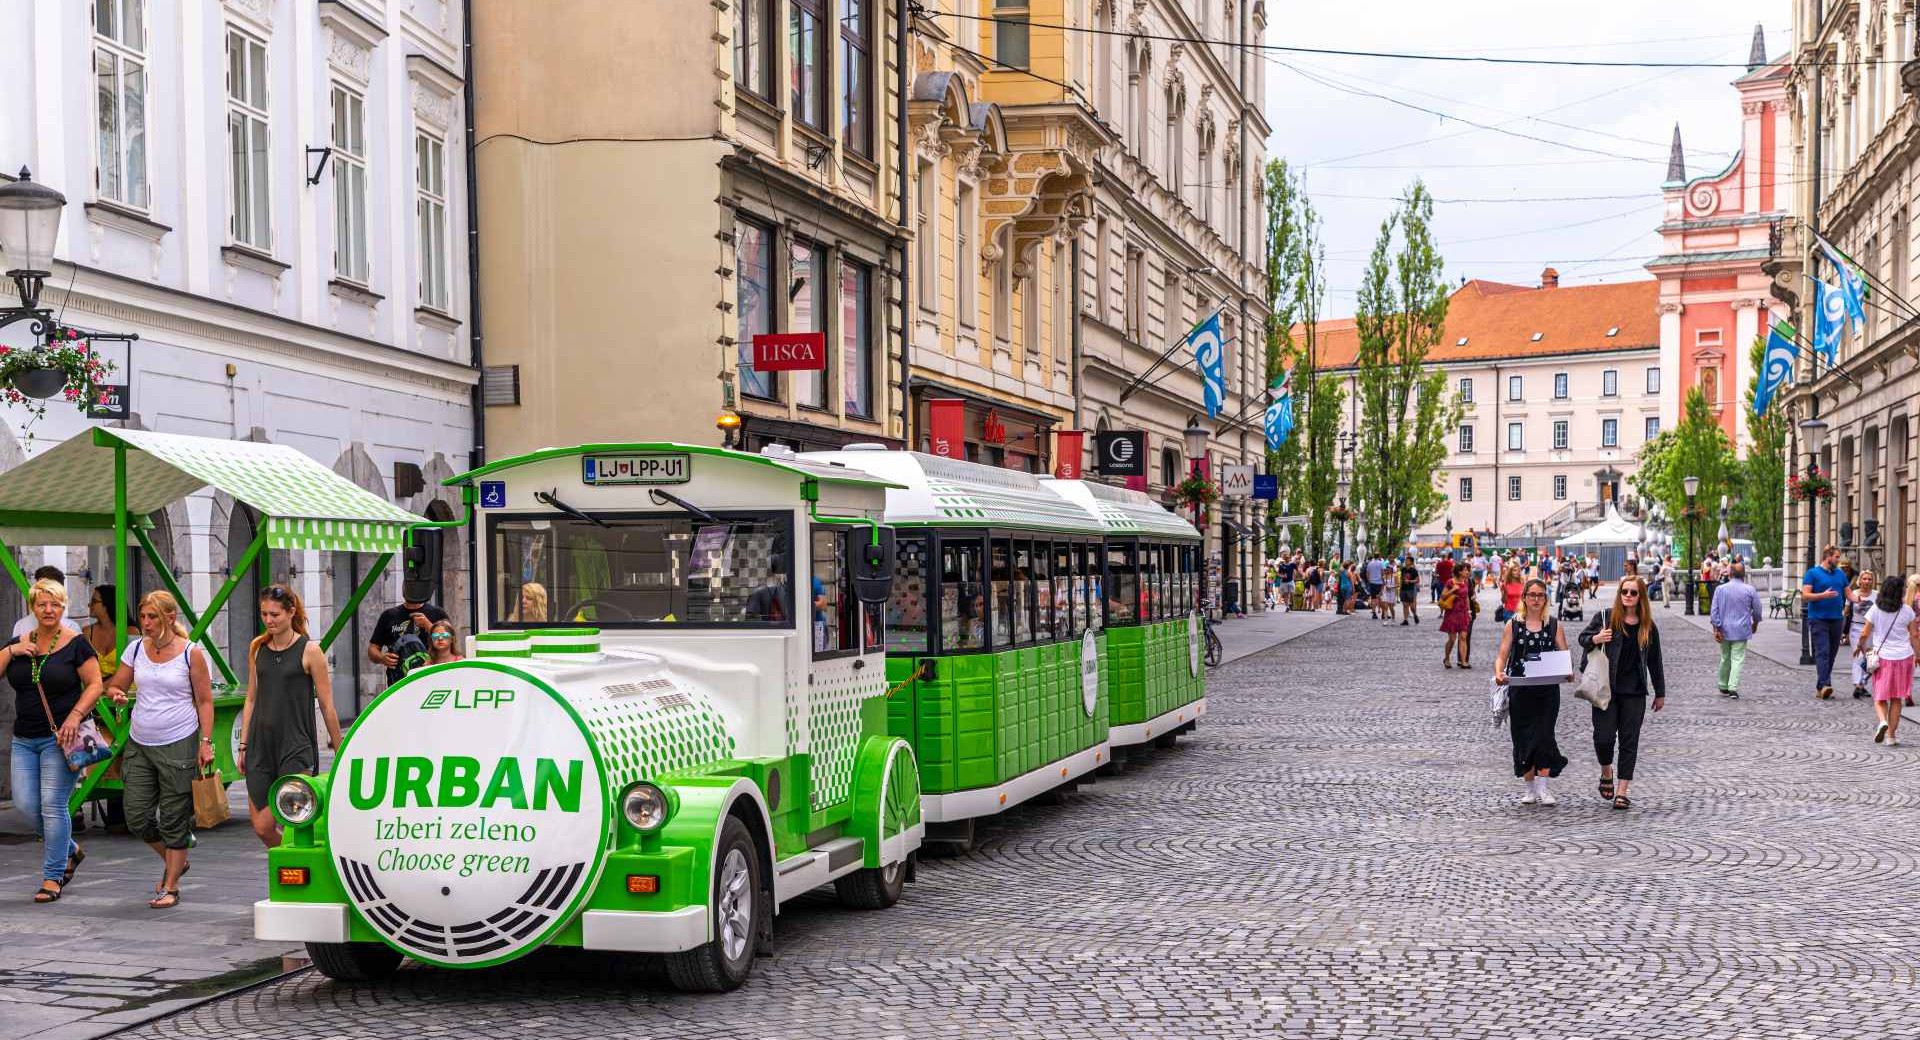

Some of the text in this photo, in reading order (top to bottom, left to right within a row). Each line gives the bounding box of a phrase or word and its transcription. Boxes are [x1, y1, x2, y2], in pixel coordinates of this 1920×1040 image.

[762, 343, 816, 360] LISCA
[600, 459, 682, 477] LJ LPP-U1
[454, 689, 516, 709] LPP
[349, 755, 584, 813] URBAN
[375, 816, 536, 843] Izberi zeleno
[377, 847, 530, 878] Choose green
